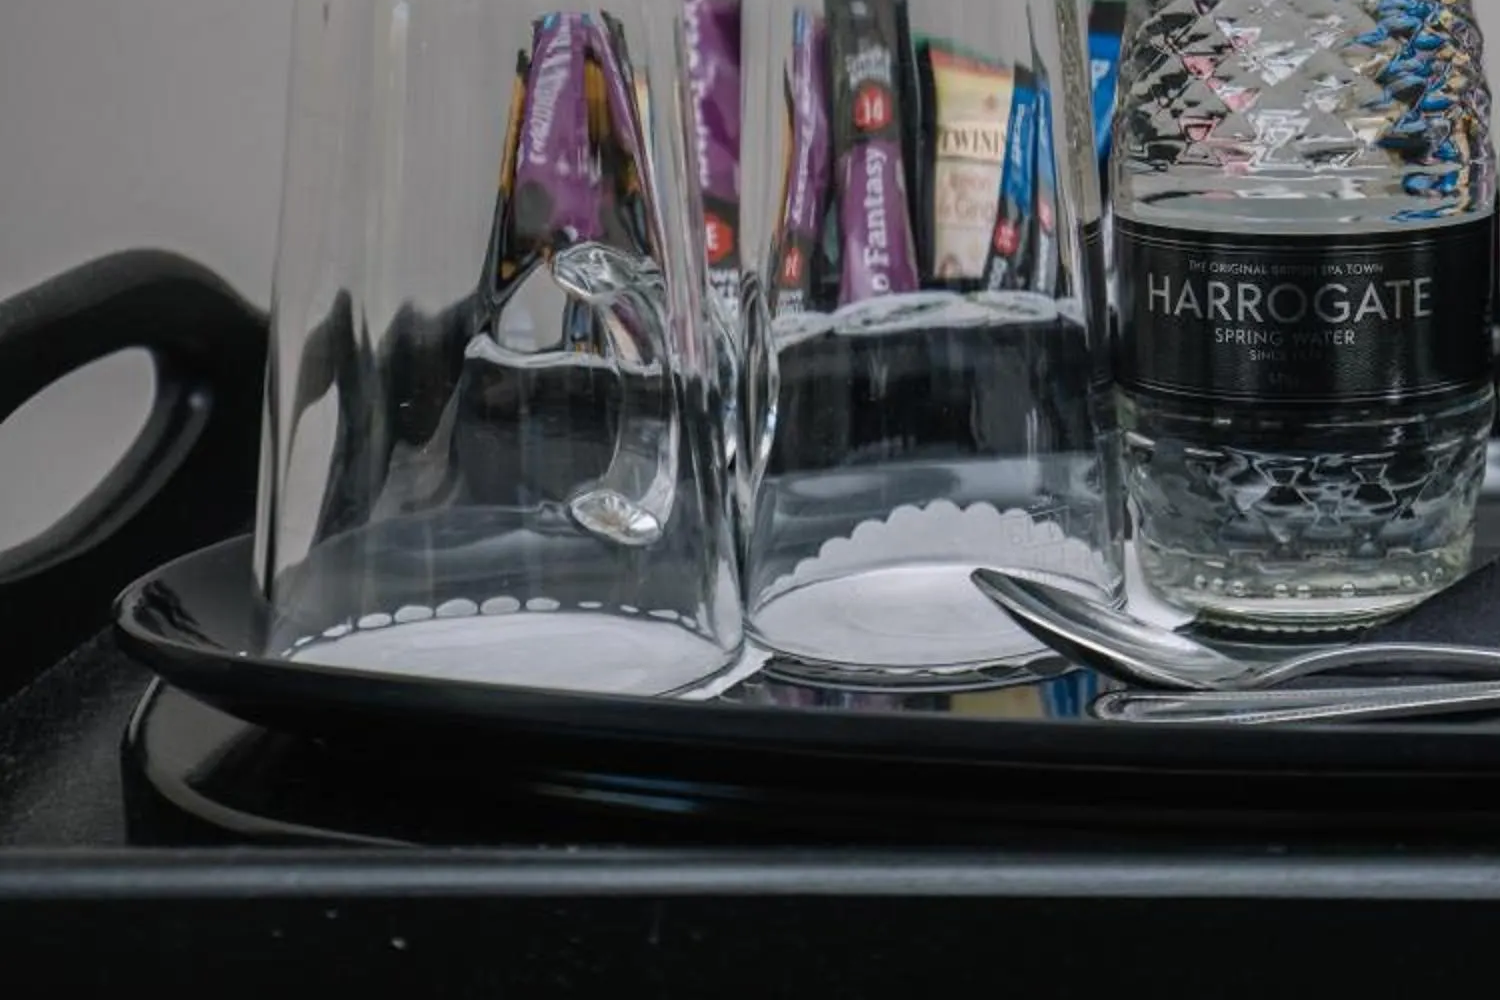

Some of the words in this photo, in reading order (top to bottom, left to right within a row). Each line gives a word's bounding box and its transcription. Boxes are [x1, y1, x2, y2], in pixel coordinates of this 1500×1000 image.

[940, 128, 1005, 153] TWINI
[863, 147, 891, 268] Fantasy
[1209, 261, 1267, 275] ORIGINAL
[1345, 262, 1385, 276] TOWN
[1147, 272, 1433, 324] HARROGATE
[1214, 327, 1283, 347] SPRING
[1292, 327, 1356, 346] WATER
